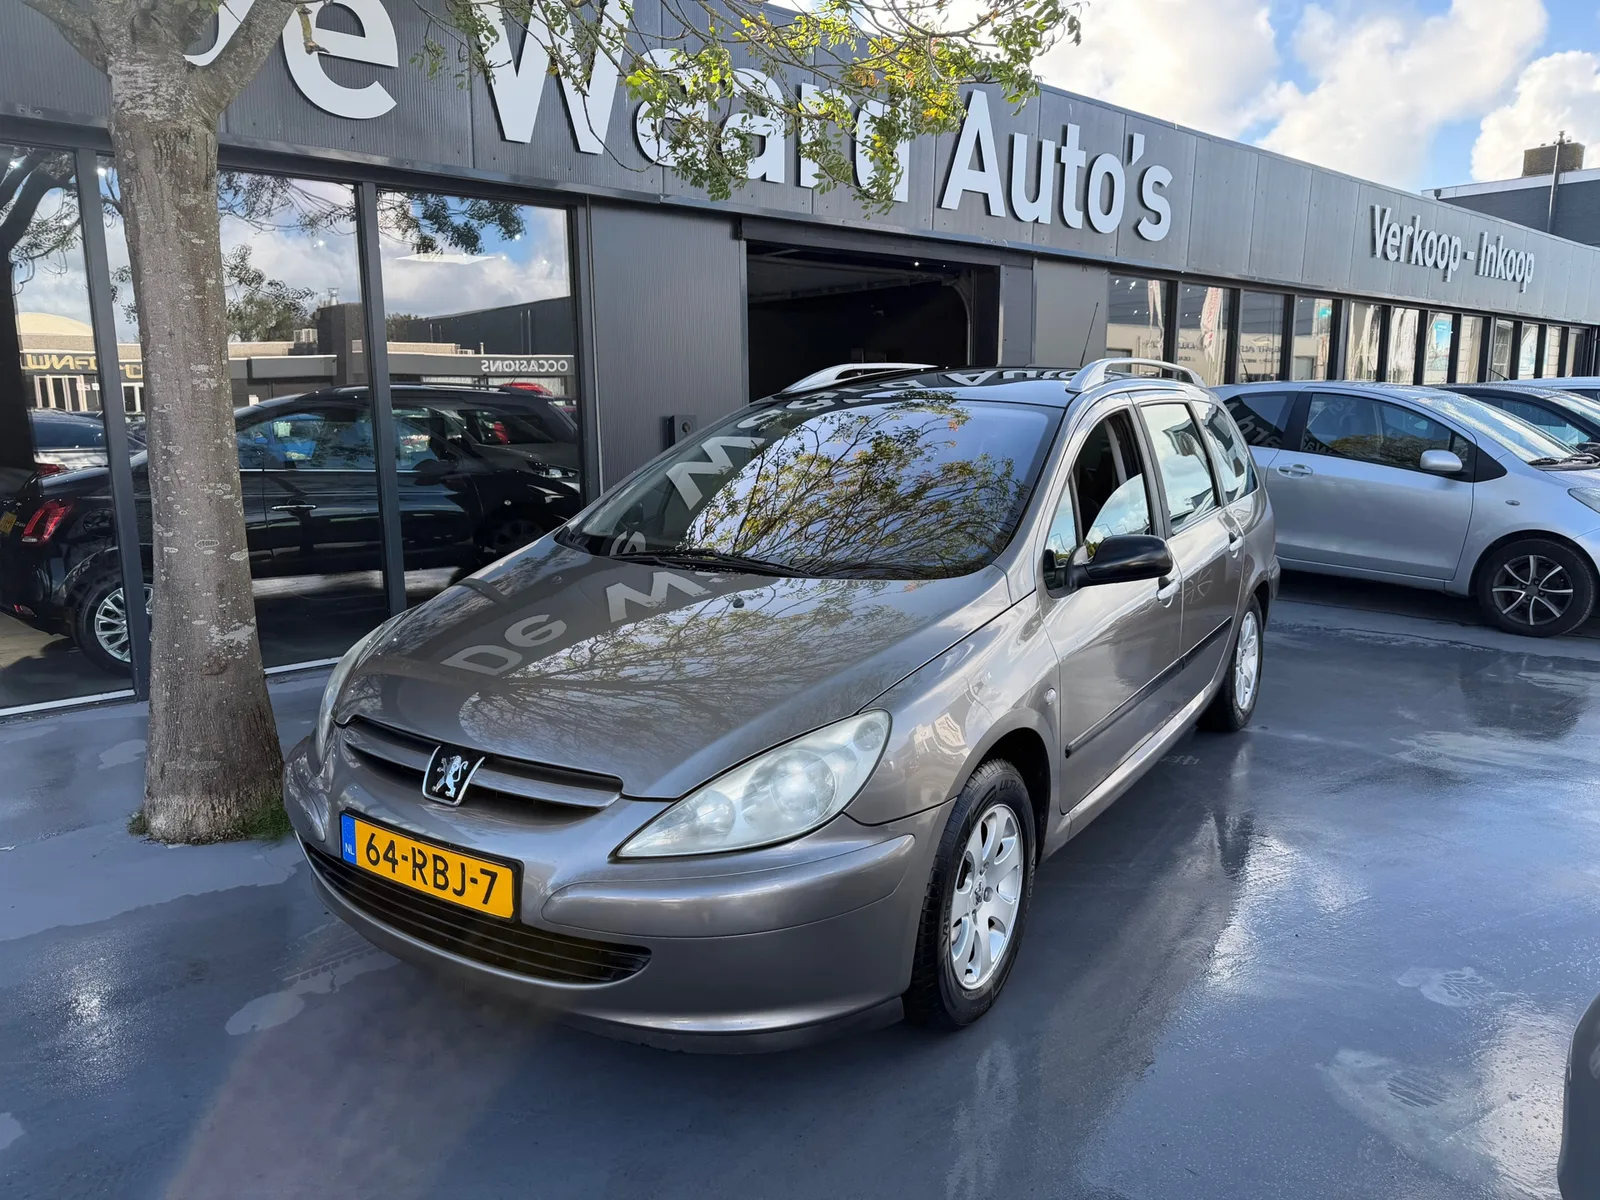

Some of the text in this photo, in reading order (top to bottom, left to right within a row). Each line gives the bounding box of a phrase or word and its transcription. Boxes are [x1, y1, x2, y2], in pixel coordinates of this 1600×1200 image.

[941, 89, 1173, 242] Auto's
[1374, 204, 1462, 282] Verkoop
[1478, 231, 1534, 293] Inkoop
[344, 842, 355, 856] NL
[365, 832, 498, 905] 64-RBJ-7
